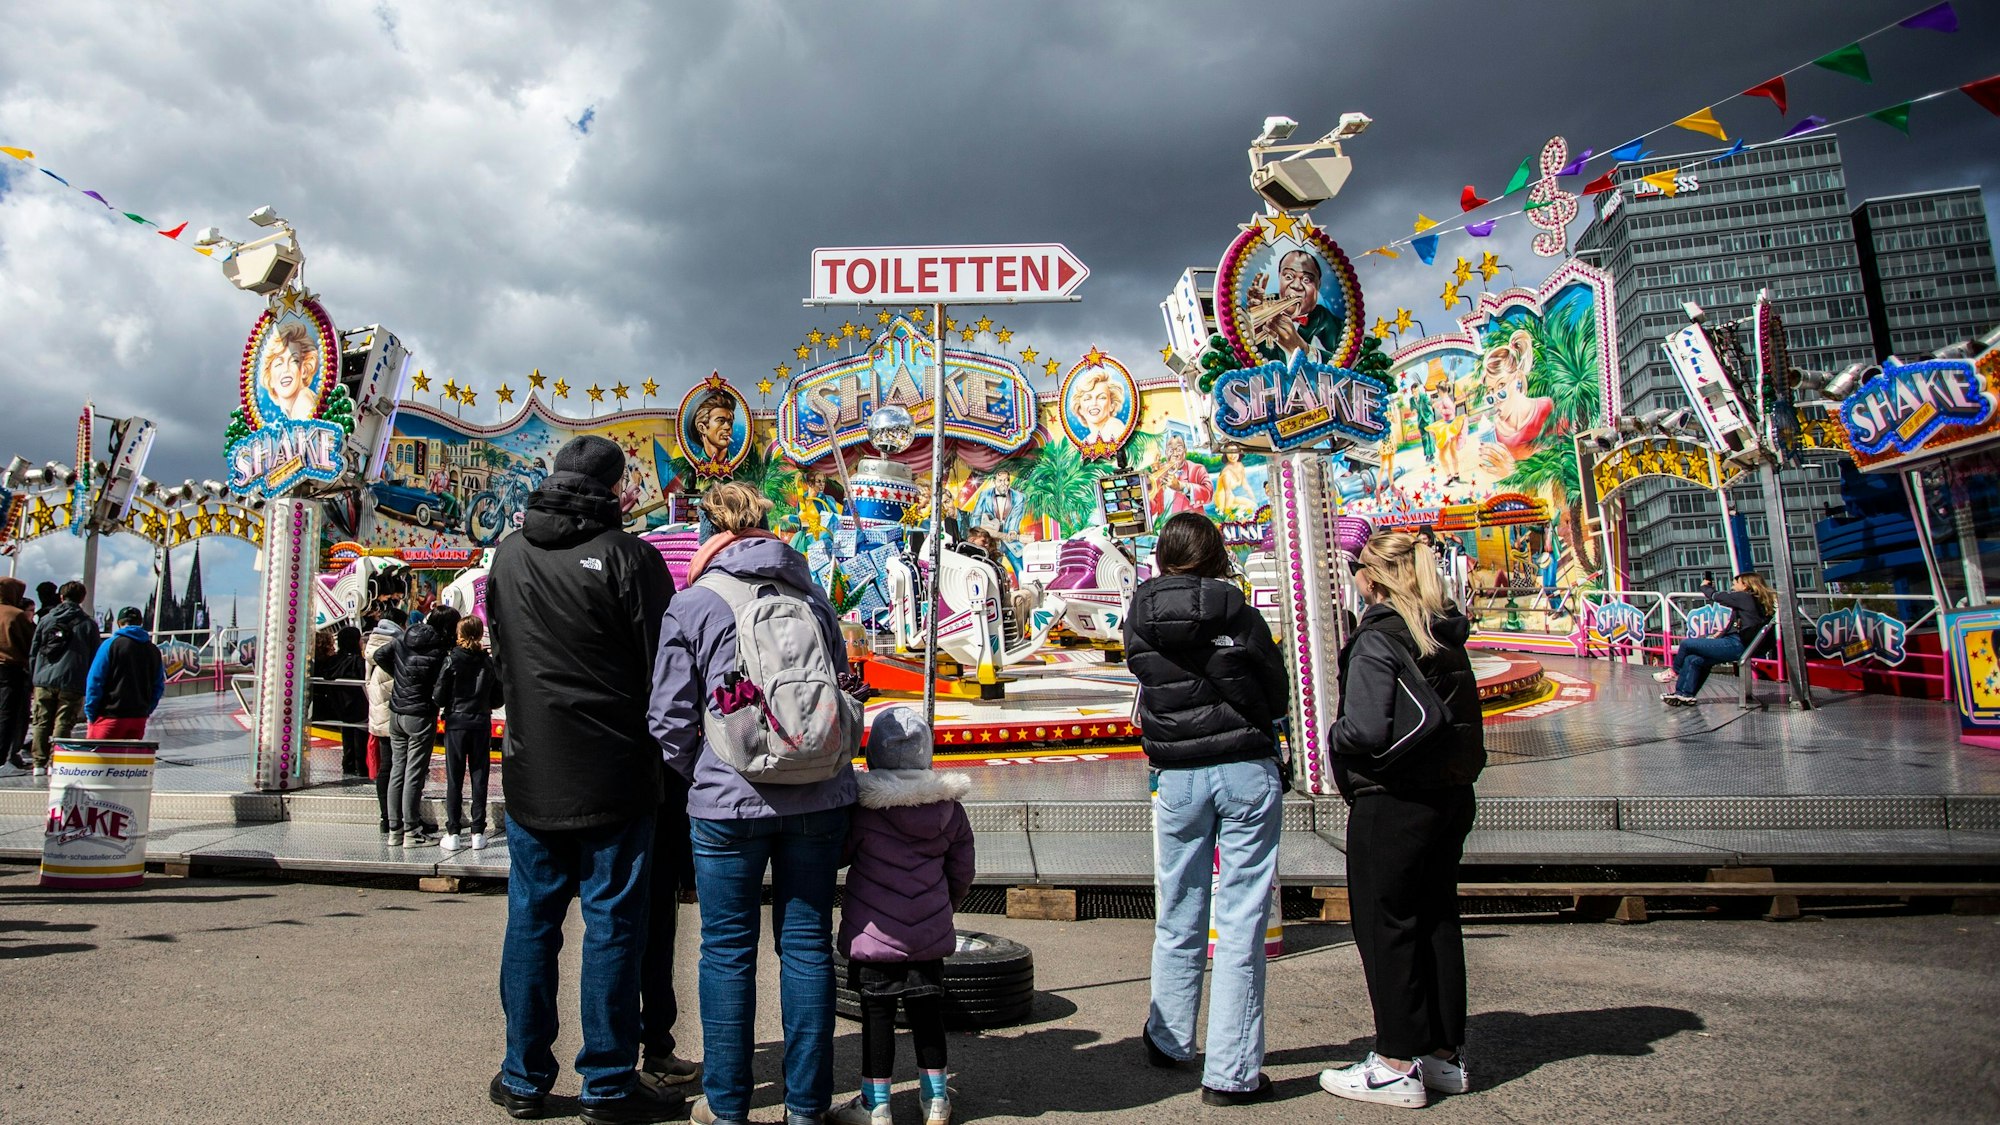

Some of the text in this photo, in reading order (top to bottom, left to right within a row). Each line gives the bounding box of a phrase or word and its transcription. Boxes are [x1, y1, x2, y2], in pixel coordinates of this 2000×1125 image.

[821, 255, 1049, 294] TOILETTEN
[806, 361, 1007, 432] SHAKE
[1223, 366, 1385, 431] SHAKE
[1851, 369, 1981, 443] SHAKE
[233, 426, 337, 487] SHAKE
[1600, 608, 1643, 638] SHAKE
[1689, 608, 1732, 639] SHA
[1819, 614, 1900, 657] SHAKE
[159, 644, 199, 671] HAKE
[58, 766, 104, 777] Sauberer
[105, 767, 149, 780] Festplatz
[984, 753, 1110, 767] STOP
[46, 804, 130, 841] HAKE
